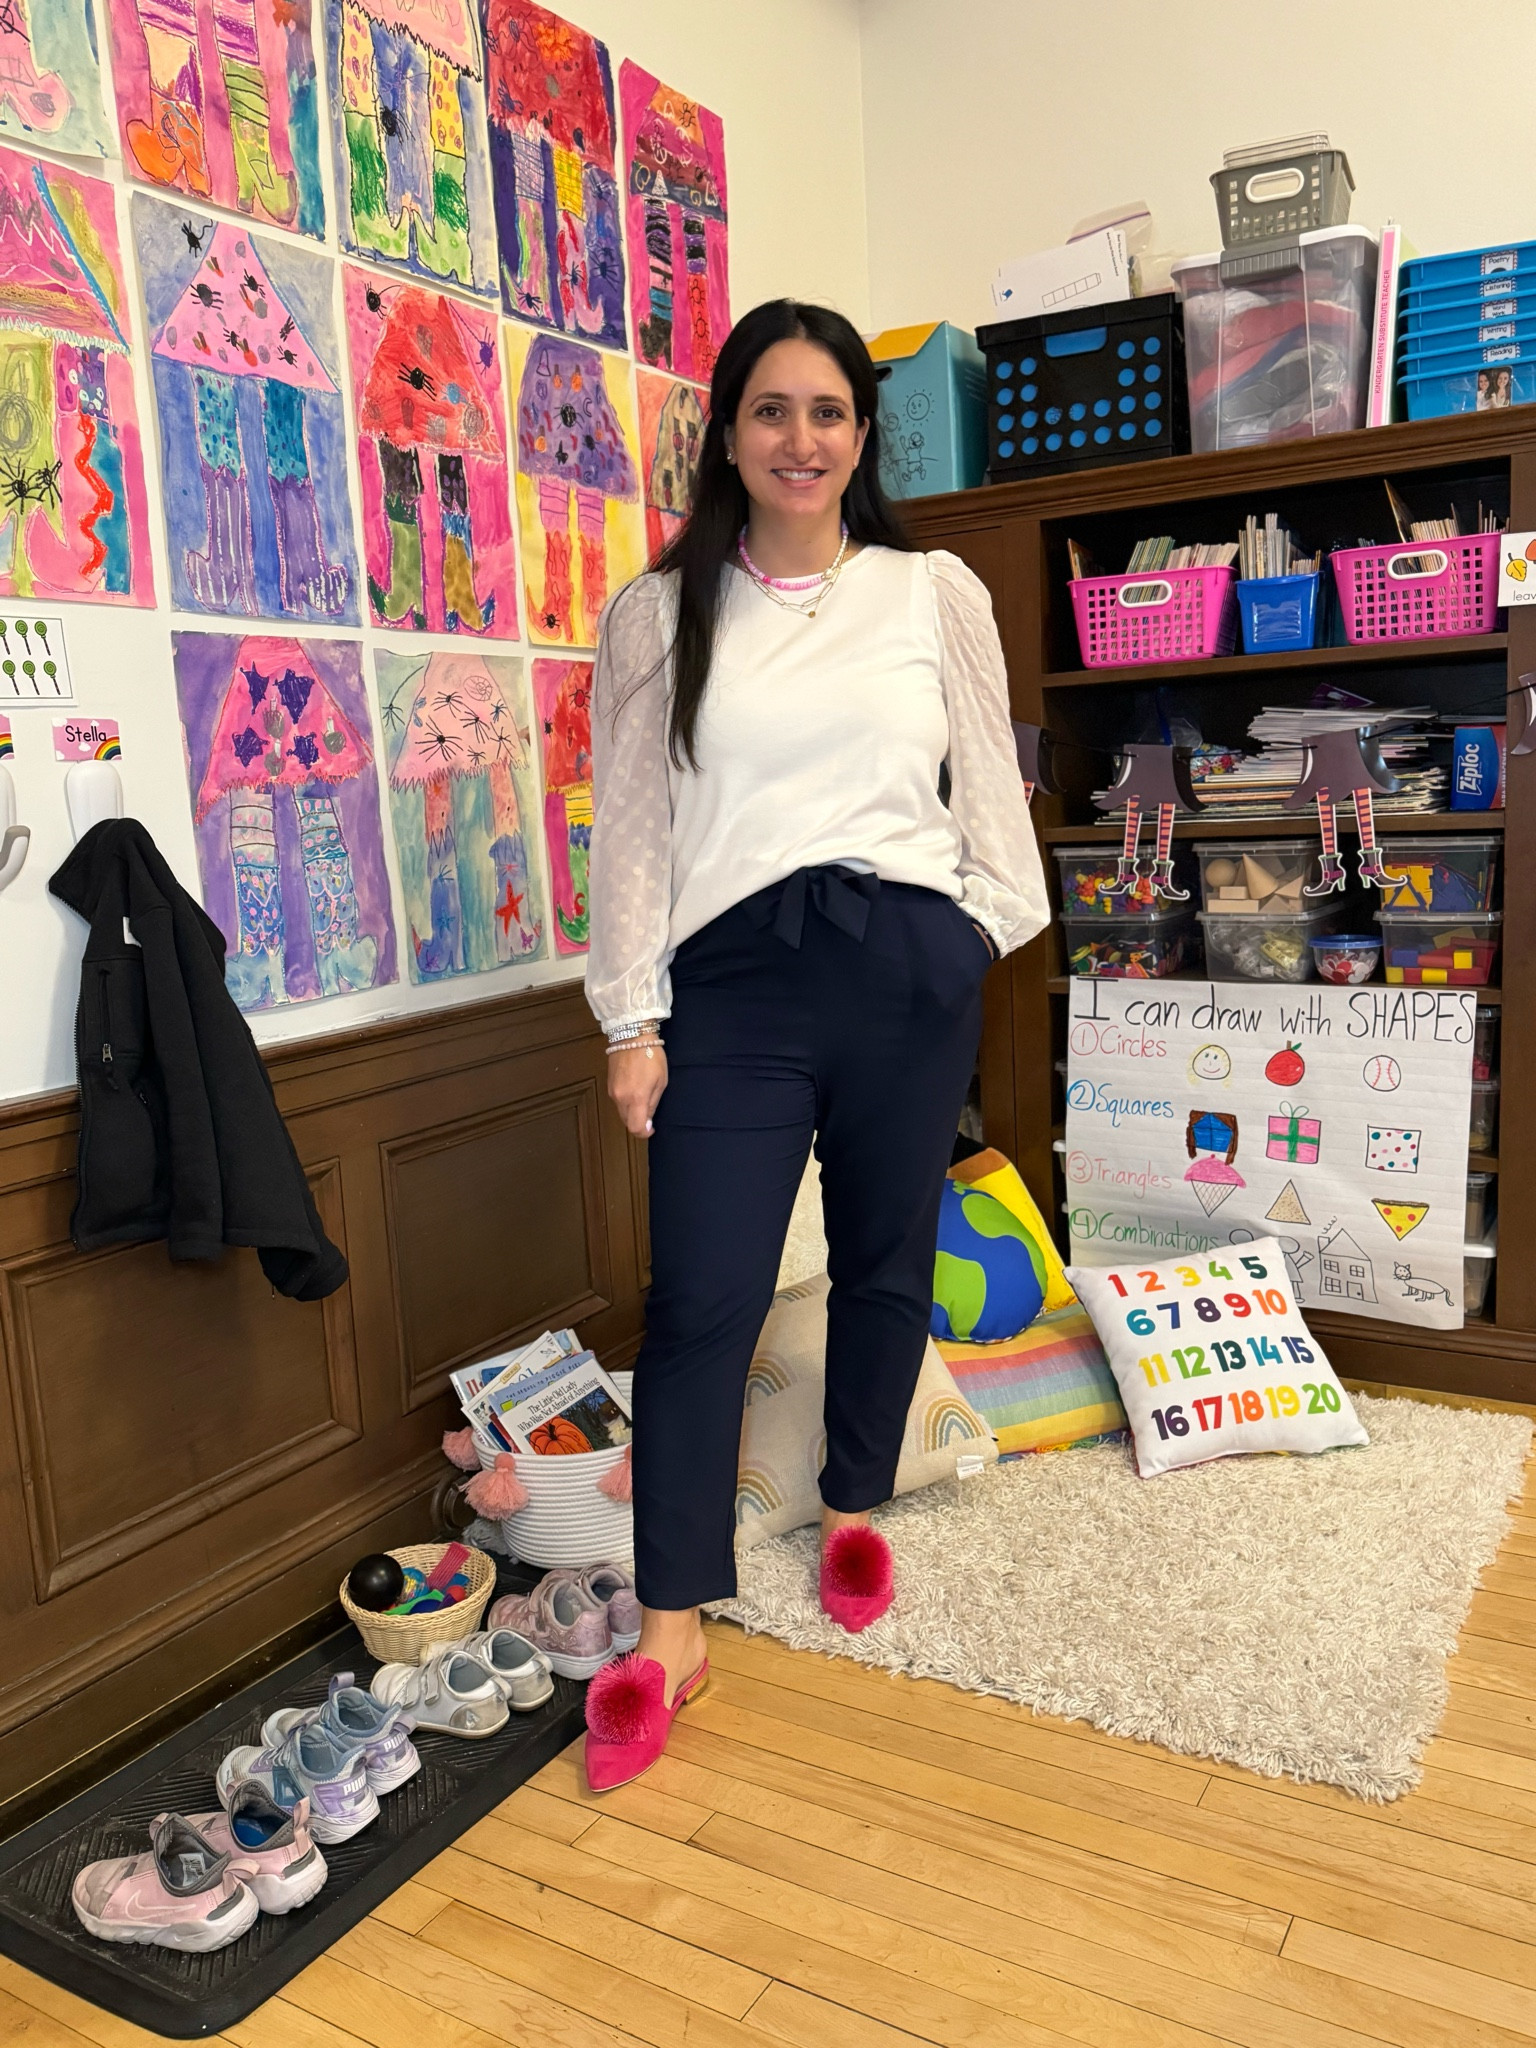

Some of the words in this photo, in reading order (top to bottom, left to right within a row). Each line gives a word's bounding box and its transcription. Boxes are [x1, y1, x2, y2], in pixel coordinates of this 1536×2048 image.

[1488, 256, 1511, 264] Poetry
[1382, 270, 1391, 300] TEACHER
[1485, 282, 1511, 292] Listening
[1378, 301, 1388, 341] SUBSTITUTE
[1486, 326, 1508, 334] Writing
[1375, 341, 1385, 394] KINDERGARTEN
[1490, 347, 1513, 357] Reading
[65, 725, 107, 743] Stella
[1459, 743, 1483, 791] Ziploc
[1074, 976, 1118, 1021] I
[1124, 999, 1180, 1030] can
[1191, 984, 1262, 1033] draw
[1280, 993, 1331, 1036] with
[1347, 990, 1476, 1045] SHAPES
[1099, 1025, 1167, 1058] Circles
[1096, 1083, 1175, 1128] Squares
[1093, 1158, 1173, 1199] Triangles
[1098, 1212, 1220, 1253] Combinations
[1107, 1274, 1129, 1298] 1
[1136, 1270, 1166, 1293] 2
[1174, 1265, 1201, 1287] 3
[1208, 1260, 1233, 1281] 4
[1239, 1255, 1268, 1279] 5
[1126, 1308, 1156, 1336] 6
[1156, 1301, 1181, 1330] 7
[1193, 1297, 1222, 1323] 8
[1223, 1293, 1251, 1317] 9
[1252, 1288, 1288, 1316] 10
[1138, 1353, 1171, 1388] 11
[1171, 1345, 1212, 1379] 12
[1210, 1339, 1246, 1372] 13
[1246, 1335, 1283, 1367] 14
[1281, 1336, 1315, 1364] 15
[517, 1421, 533, 1432] Who
[529, 1413, 544, 1424] Was
[540, 1407, 552, 1418] Not
[551, 1398, 570, 1413] Afraid
[574, 1377, 600, 1397] Anything
[527, 1403, 540, 1415] The
[538, 1395, 553, 1408] Little
[552, 1387, 564, 1399] Old
[561, 1380, 578, 1394] Lady
[1151, 1405, 1190, 1440] 16
[1191, 1395, 1223, 1432] 17
[1228, 1390, 1264, 1424] 18
[1264, 1385, 1301, 1419] 19
[1301, 1382, 1341, 1415] 20
[383, 1732, 407, 1752] PUM
[343, 1776, 366, 1796] PUM
